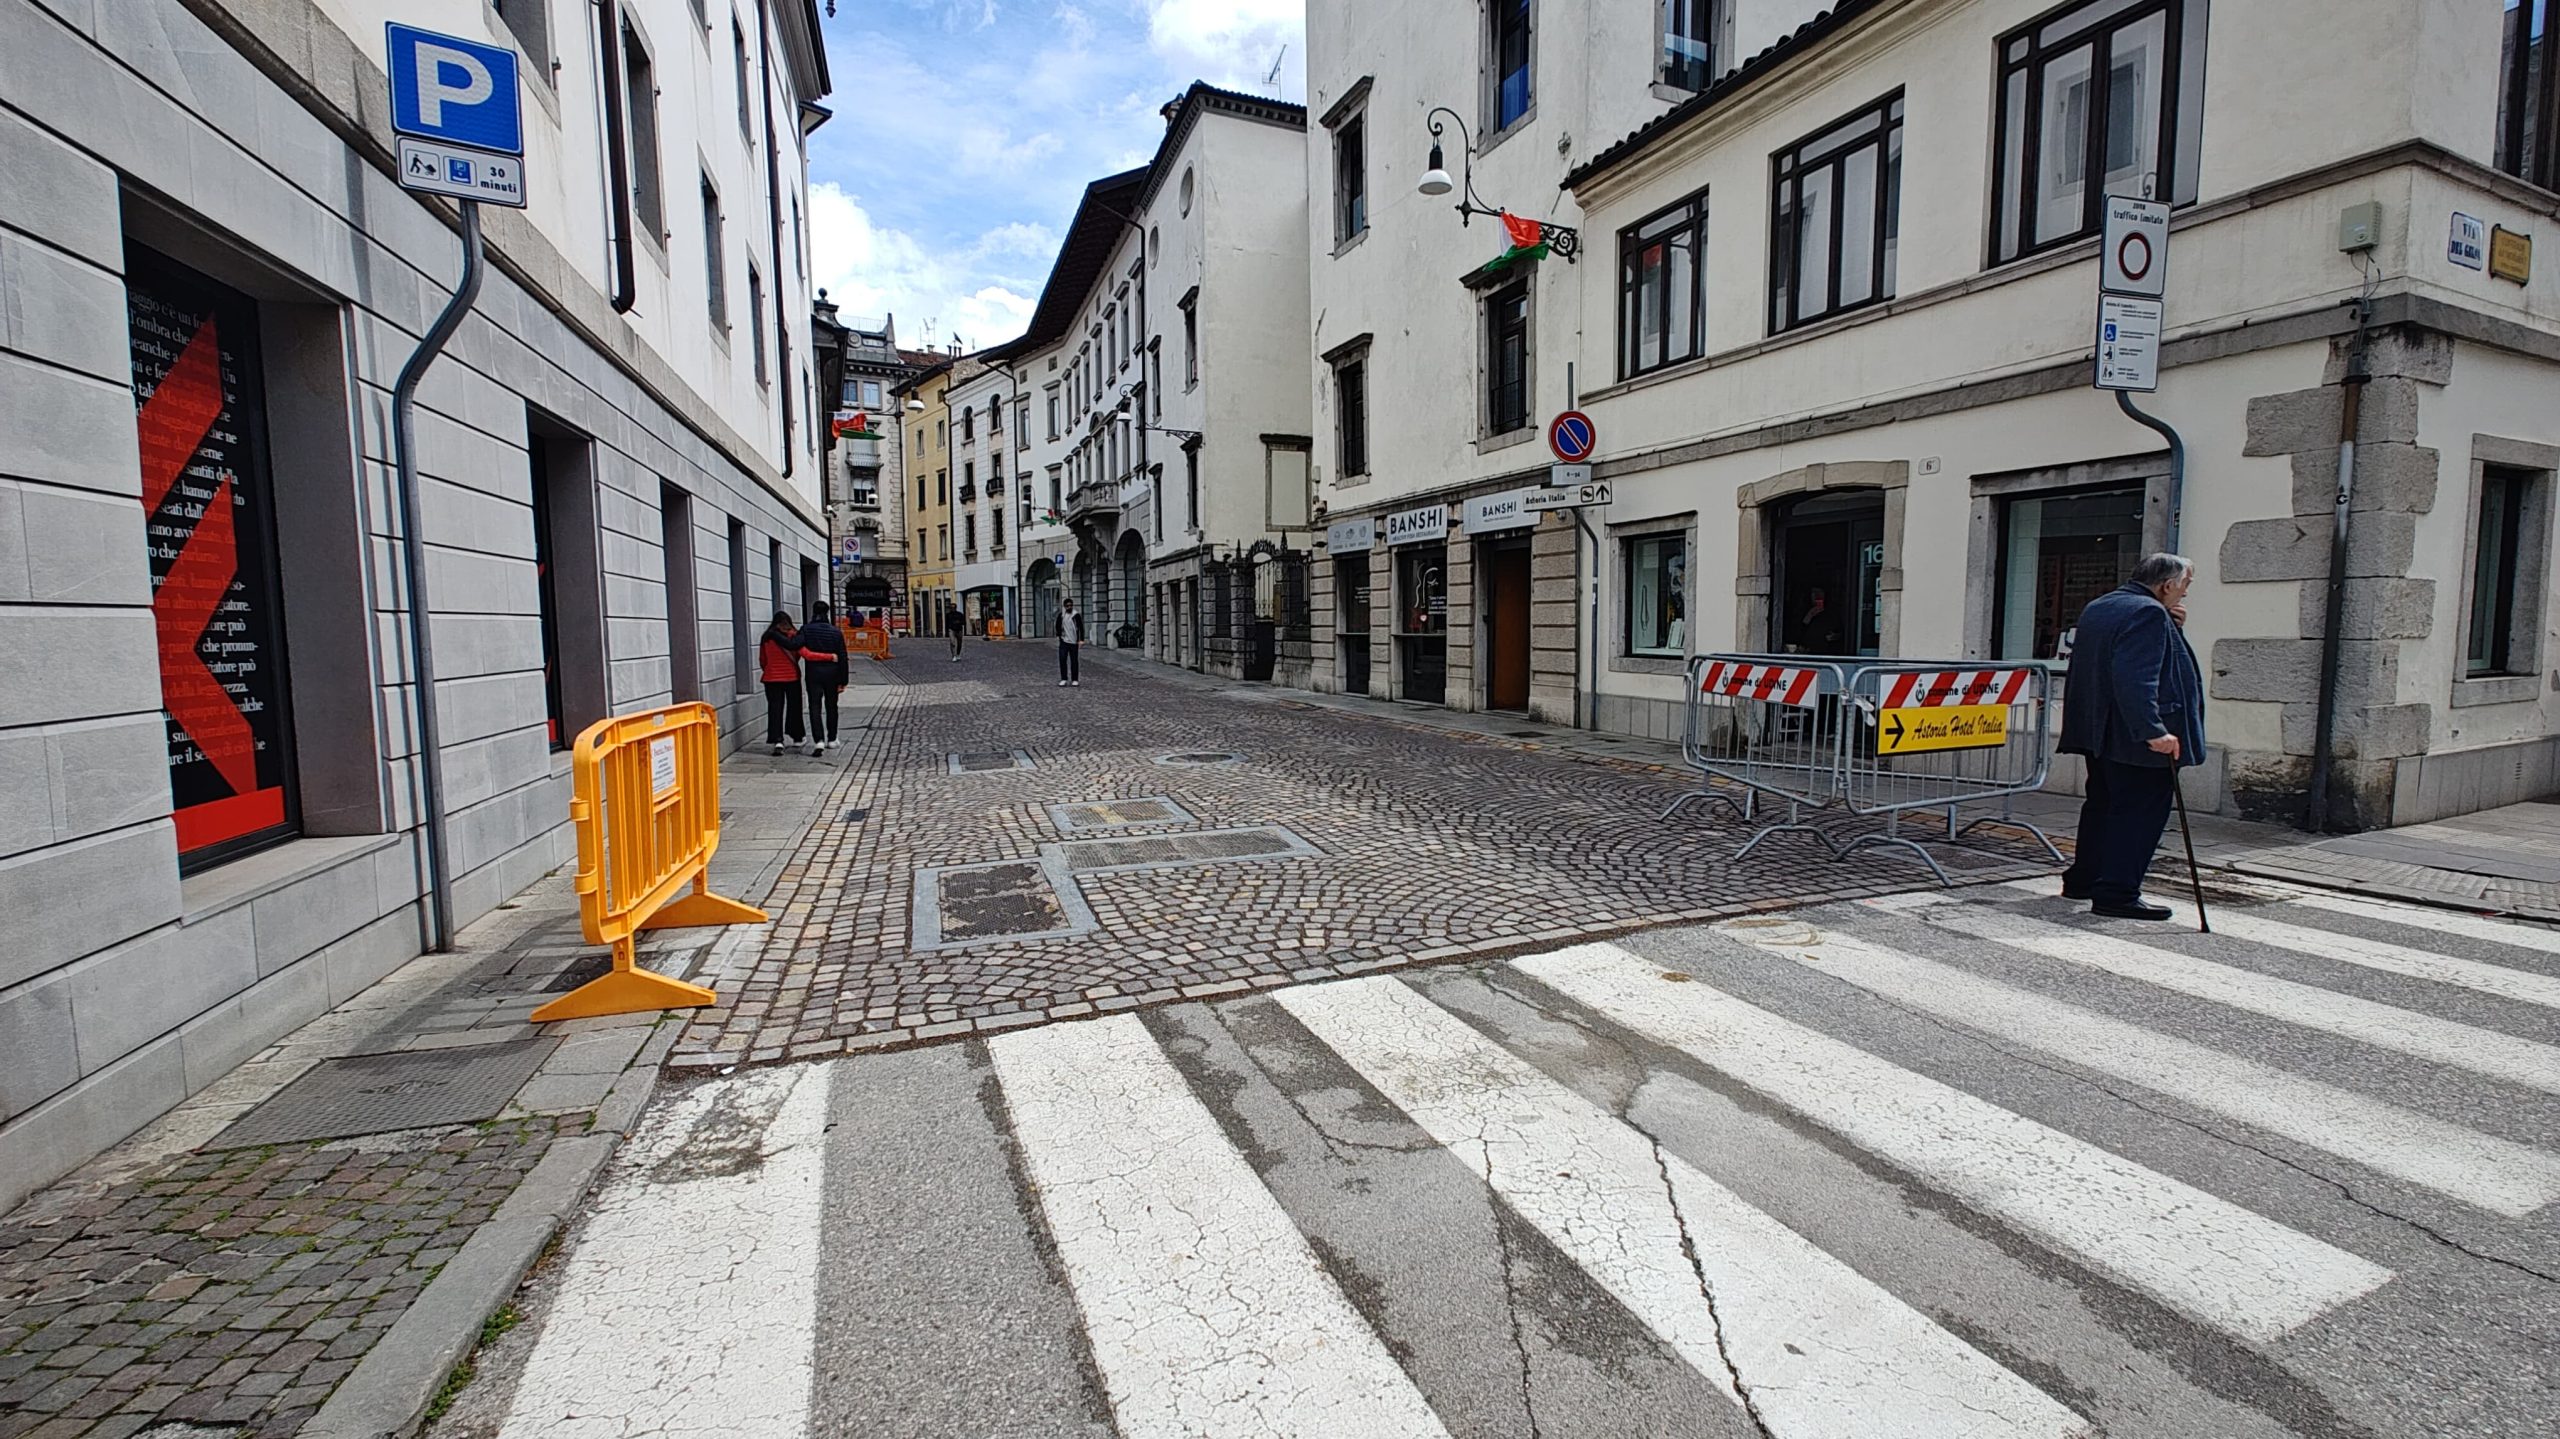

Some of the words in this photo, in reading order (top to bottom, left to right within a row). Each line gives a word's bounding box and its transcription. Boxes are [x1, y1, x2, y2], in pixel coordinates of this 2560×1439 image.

[415, 41, 494, 127] P
[490, 166, 506, 178] 30
[480, 179, 517, 193] minuti
[2114, 210, 2138, 221] traffico
[2140, 213, 2163, 225] limitato
[2463, 223, 2477, 239] VIA
[2451, 241, 2463, 256] DEL
[172, 326, 190, 345] che
[225, 432, 238, 444] ne
[181, 479, 212, 500] hanno
[1525, 496, 1547, 505] Astoria
[1549, 493, 1566, 503] Italia
[1482, 501, 1517, 517] BANSHI
[1390, 508, 1443, 535] BANSHI
[159, 543, 178, 560] che
[227, 617, 246, 636] può
[202, 637, 221, 653] che
[238, 659, 257, 677] può
[1731, 677, 1753, 687] comune
[1755, 677, 1762, 688] di
[1764, 679, 1787, 691] UDINE
[1928, 687, 1959, 697] comune
[1962, 684, 1970, 696] di
[1974, 683, 1999, 695] UDINE
[1912, 719, 1947, 741] Astoria
[1950, 715, 1975, 737] Hotel
[1978, 714, 2002, 734] Italia
[185, 746, 193, 763] il
